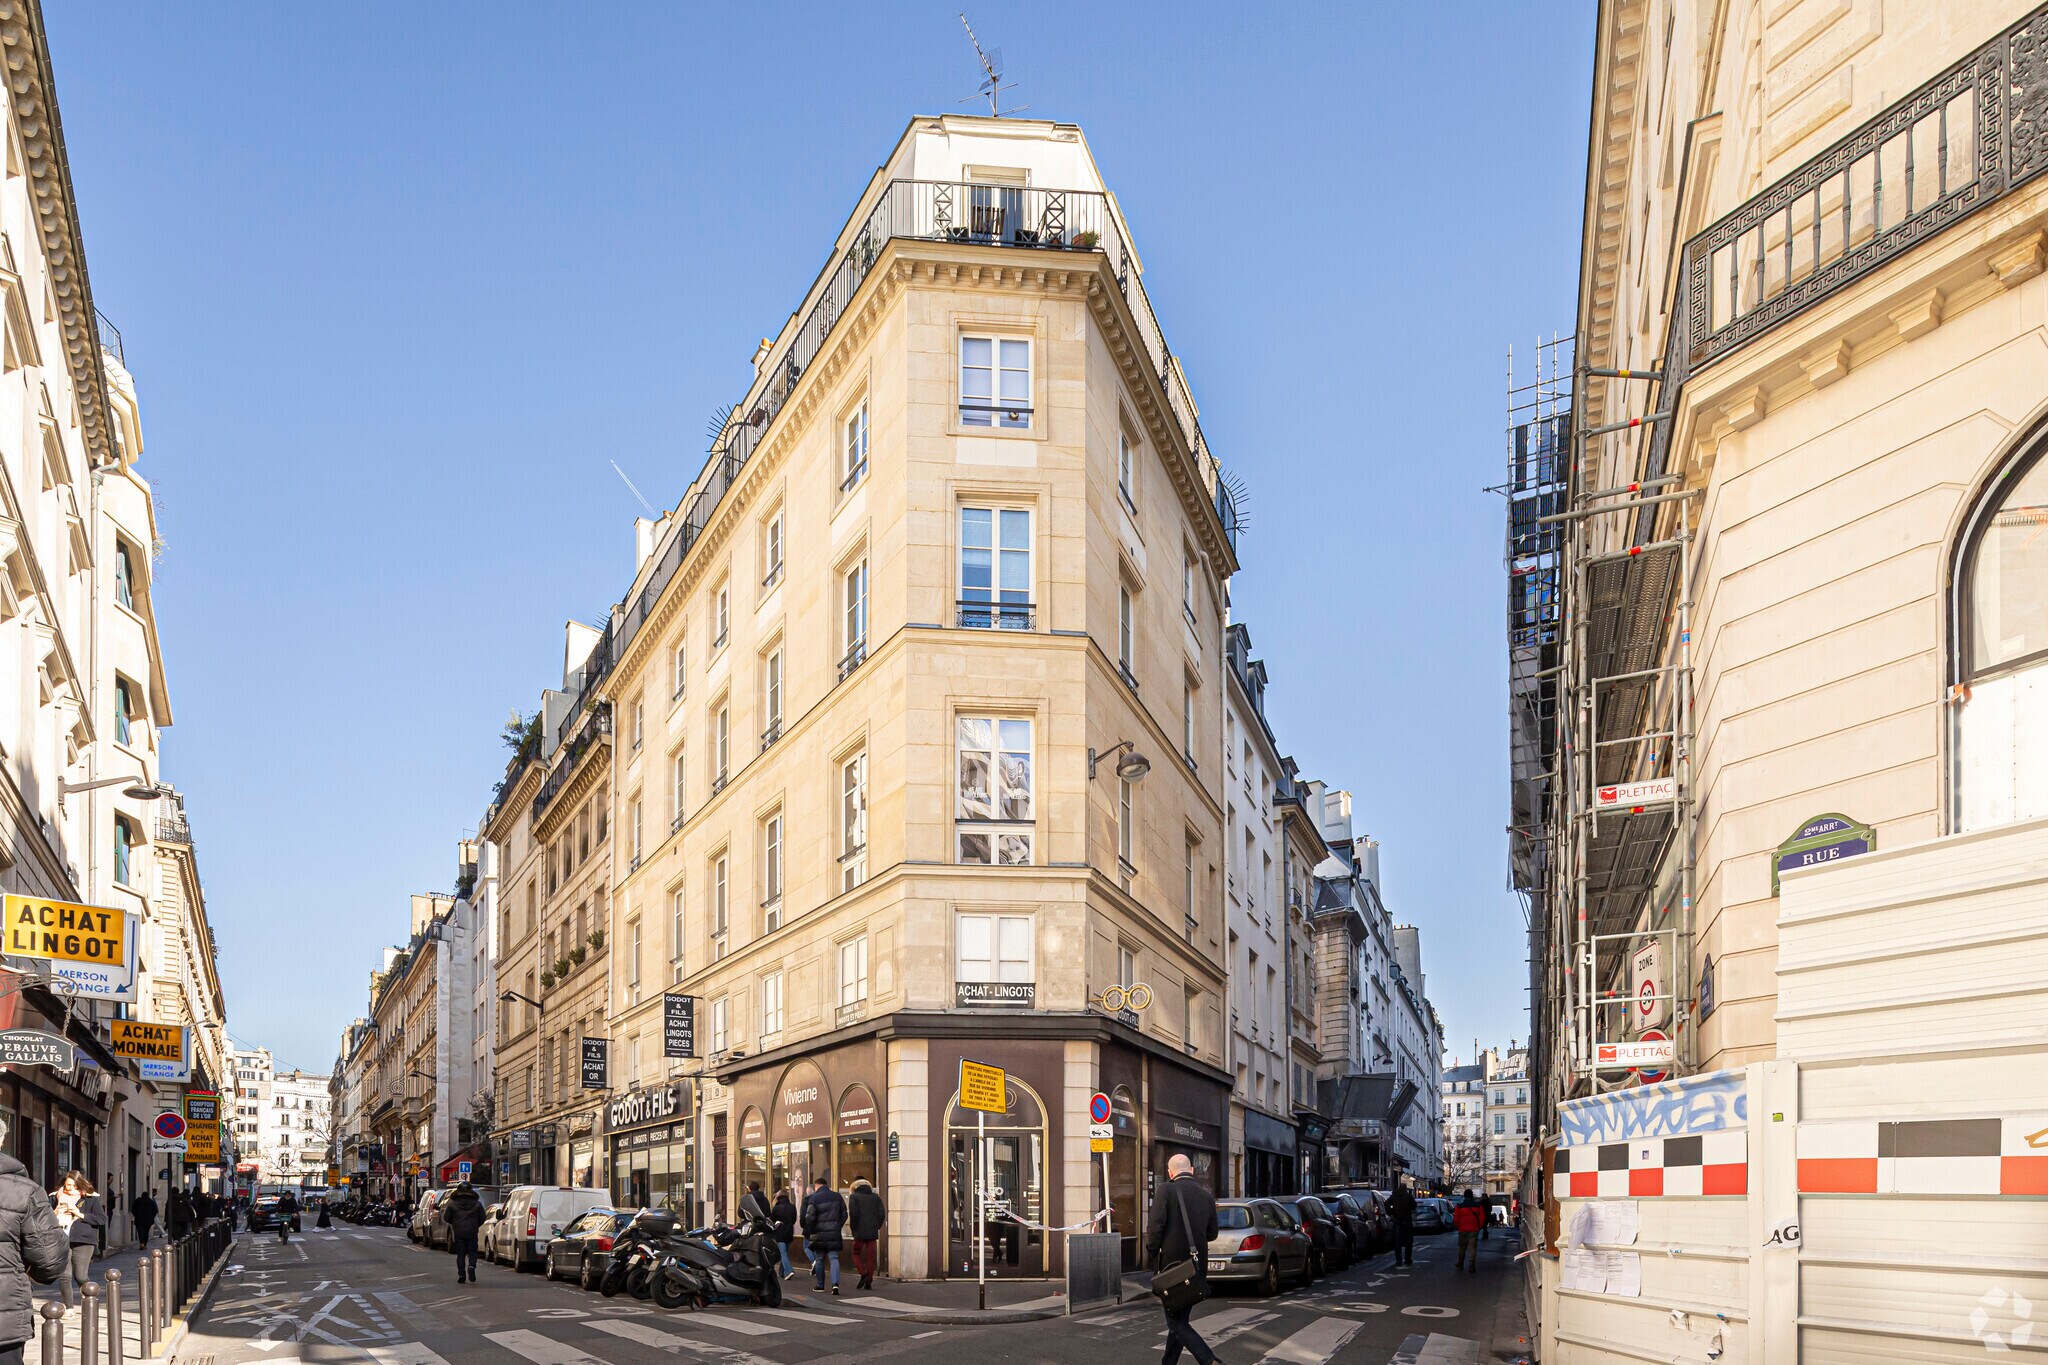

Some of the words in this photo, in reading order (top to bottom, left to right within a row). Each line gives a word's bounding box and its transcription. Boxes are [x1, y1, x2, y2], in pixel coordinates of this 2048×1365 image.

[1619, 783, 1671, 798] PLETTAC
[1803, 847, 1840, 865] RUE
[18, 905, 111, 933] ACHAT
[13, 930, 118, 959] LINGOT
[1638, 954, 1653, 971] ZONE
[58, 969, 108, 982] MERSON
[58, 981, 110, 993] CHANGE
[958, 985, 989, 996] ACHAT
[995, 986, 1034, 997] LINGOTS
[1642, 989, 1652, 1006] 30
[669, 1020, 689, 1028] ACHAT
[122, 1025, 172, 1041] ACHAT
[666, 1029, 692, 1038] LINGOTS
[113, 1040, 179, 1057] MONNAIE
[669, 1039, 690, 1048] PIECES
[6, 1052, 62, 1062] GALLAIS
[1619, 1047, 1671, 1058] PLETTAC
[143, 1063, 173, 1071] MERSON
[583, 1062, 605, 1071] ACHAT
[589, 1072, 599, 1080] OR
[784, 1087, 818, 1105] Vivienne
[611, 1097, 646, 1127] GODOT
[645, 1100, 651, 1119] &
[652, 1088, 677, 1118] FILS
[787, 1111, 814, 1129] Optique
[1174, 1122, 1189, 1136] Vivienne
[1190, 1126, 1203, 1141] Optique
[1337, 1302, 1460, 1318] 30
